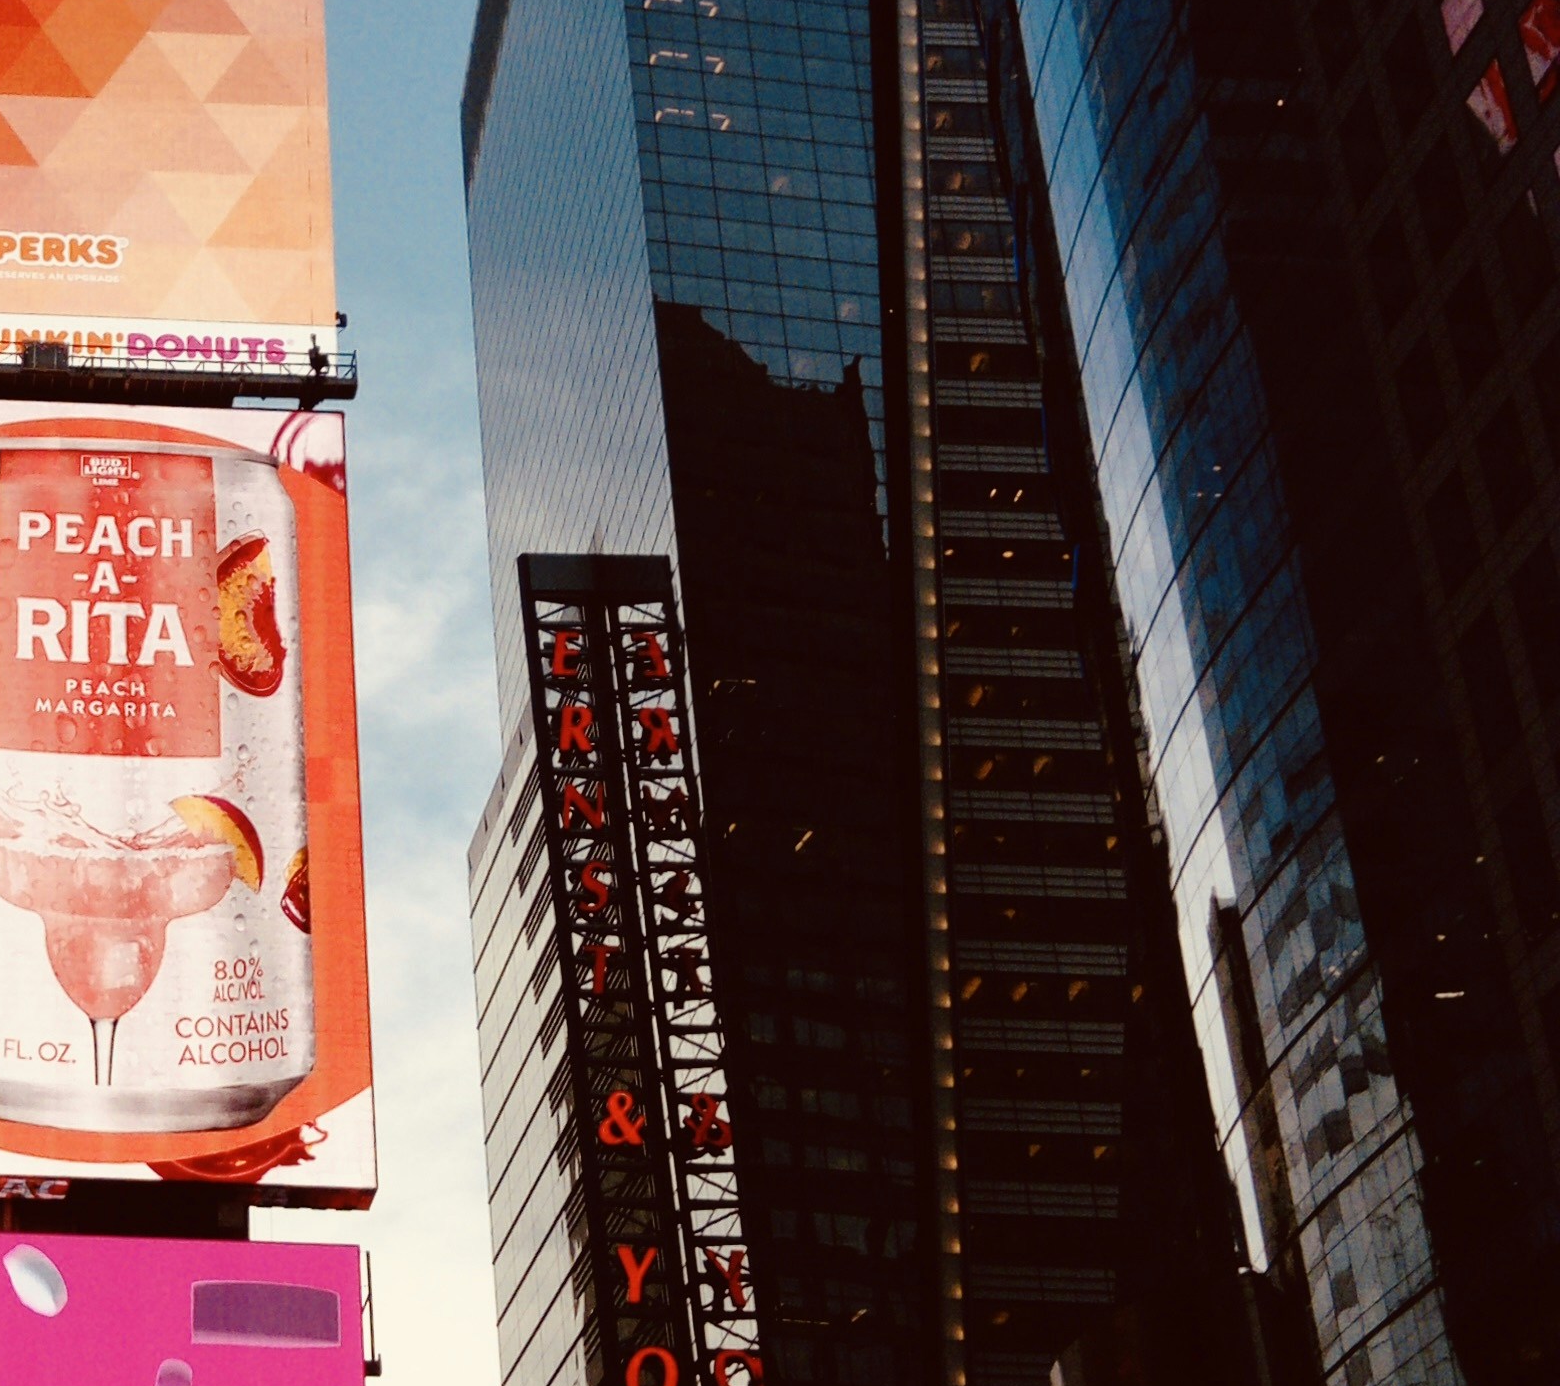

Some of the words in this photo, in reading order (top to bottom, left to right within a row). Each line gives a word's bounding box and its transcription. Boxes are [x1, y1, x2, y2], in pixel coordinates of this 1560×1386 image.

[83, 464, 128, 477] LIGHT
[18, 510, 194, 558] PEACH
[13, 597, 196, 669] RITA
[64, 678, 147, 697] PEACH
[34, 696, 179, 719] MARGARITA
[214, 955, 264, 982] 8.0%
[175, 1009, 291, 1037] CONTAINS
[3, 1037, 34, 1060] FL.
[38, 1039, 77, 1064] OZ.
[177, 1037, 290, 1067] ALCOHOL
[597, 1090, 645, 1148] &
